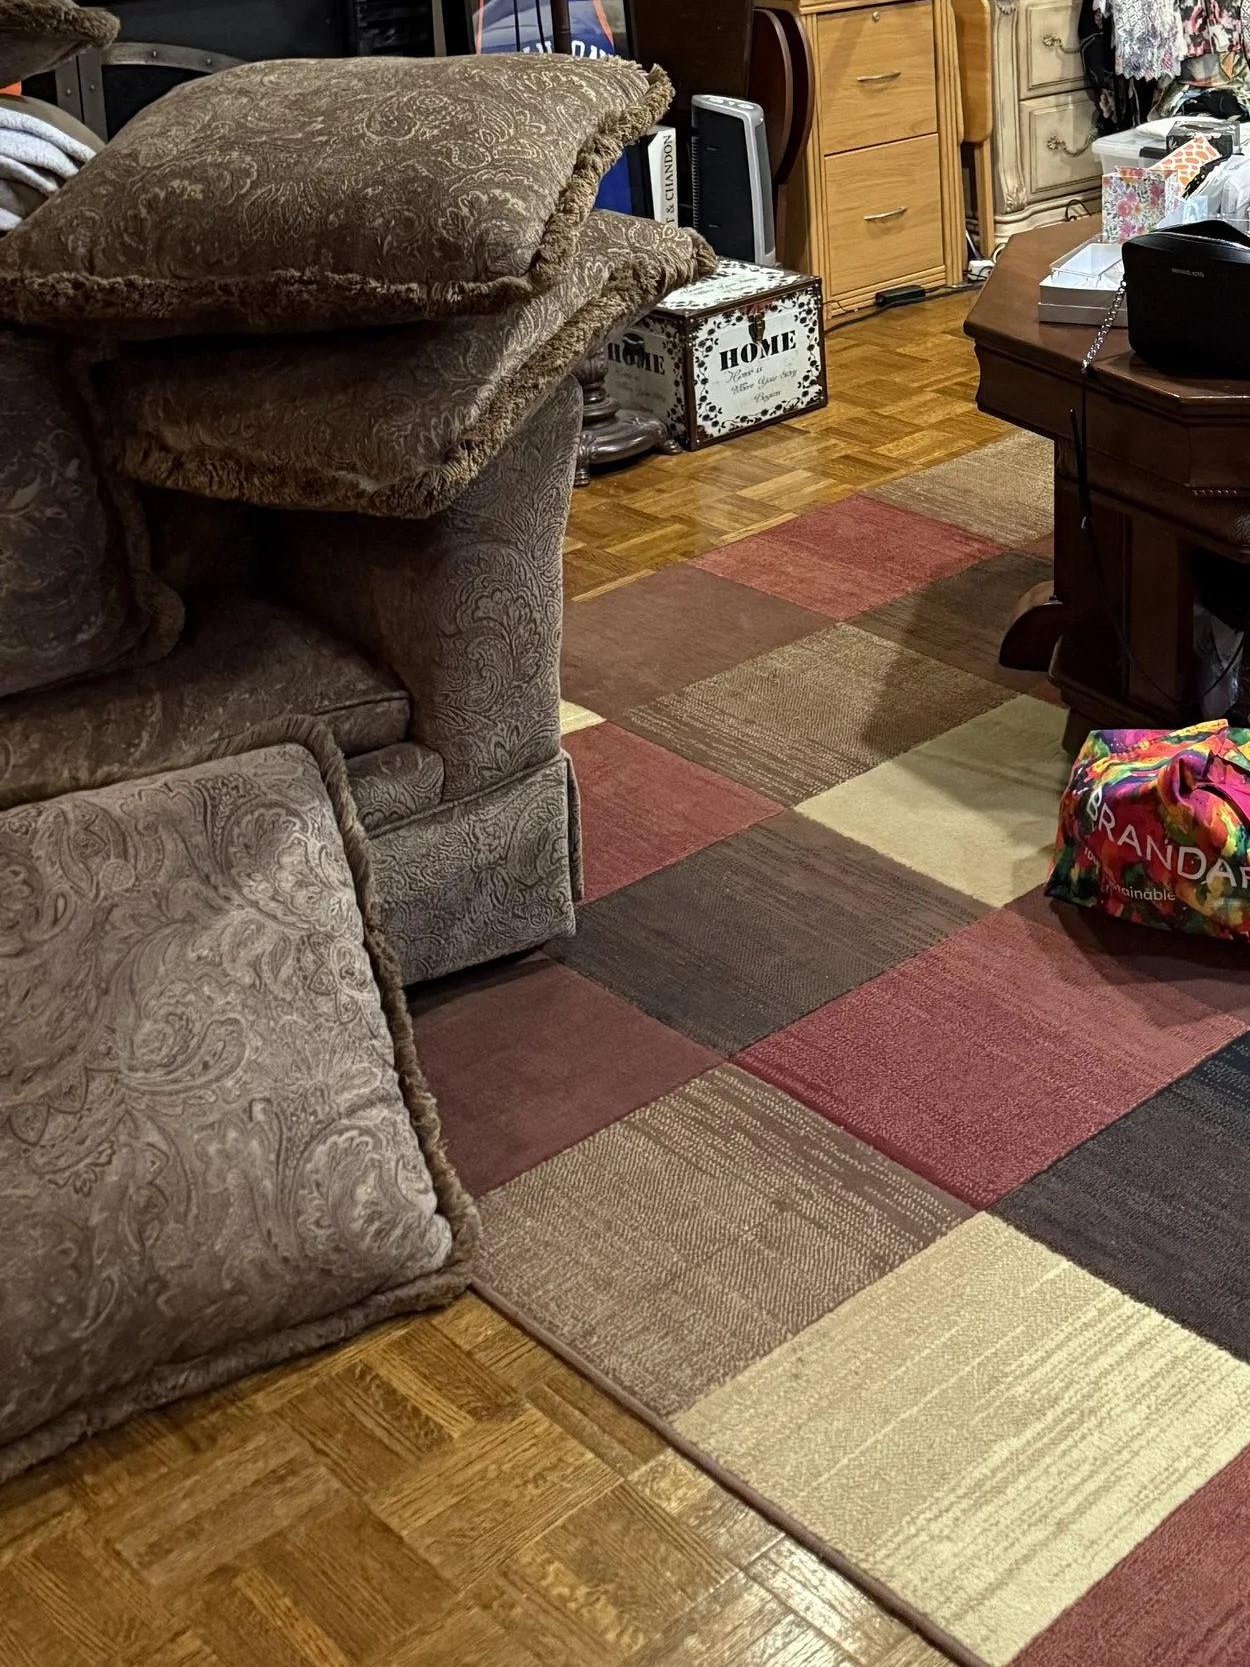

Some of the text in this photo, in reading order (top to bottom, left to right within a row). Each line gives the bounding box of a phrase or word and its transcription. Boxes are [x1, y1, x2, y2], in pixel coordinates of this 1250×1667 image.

[663, 134, 675, 201] CHANDON
[607, 343, 665, 375] HOME
[719, 330, 797, 372] HOME
